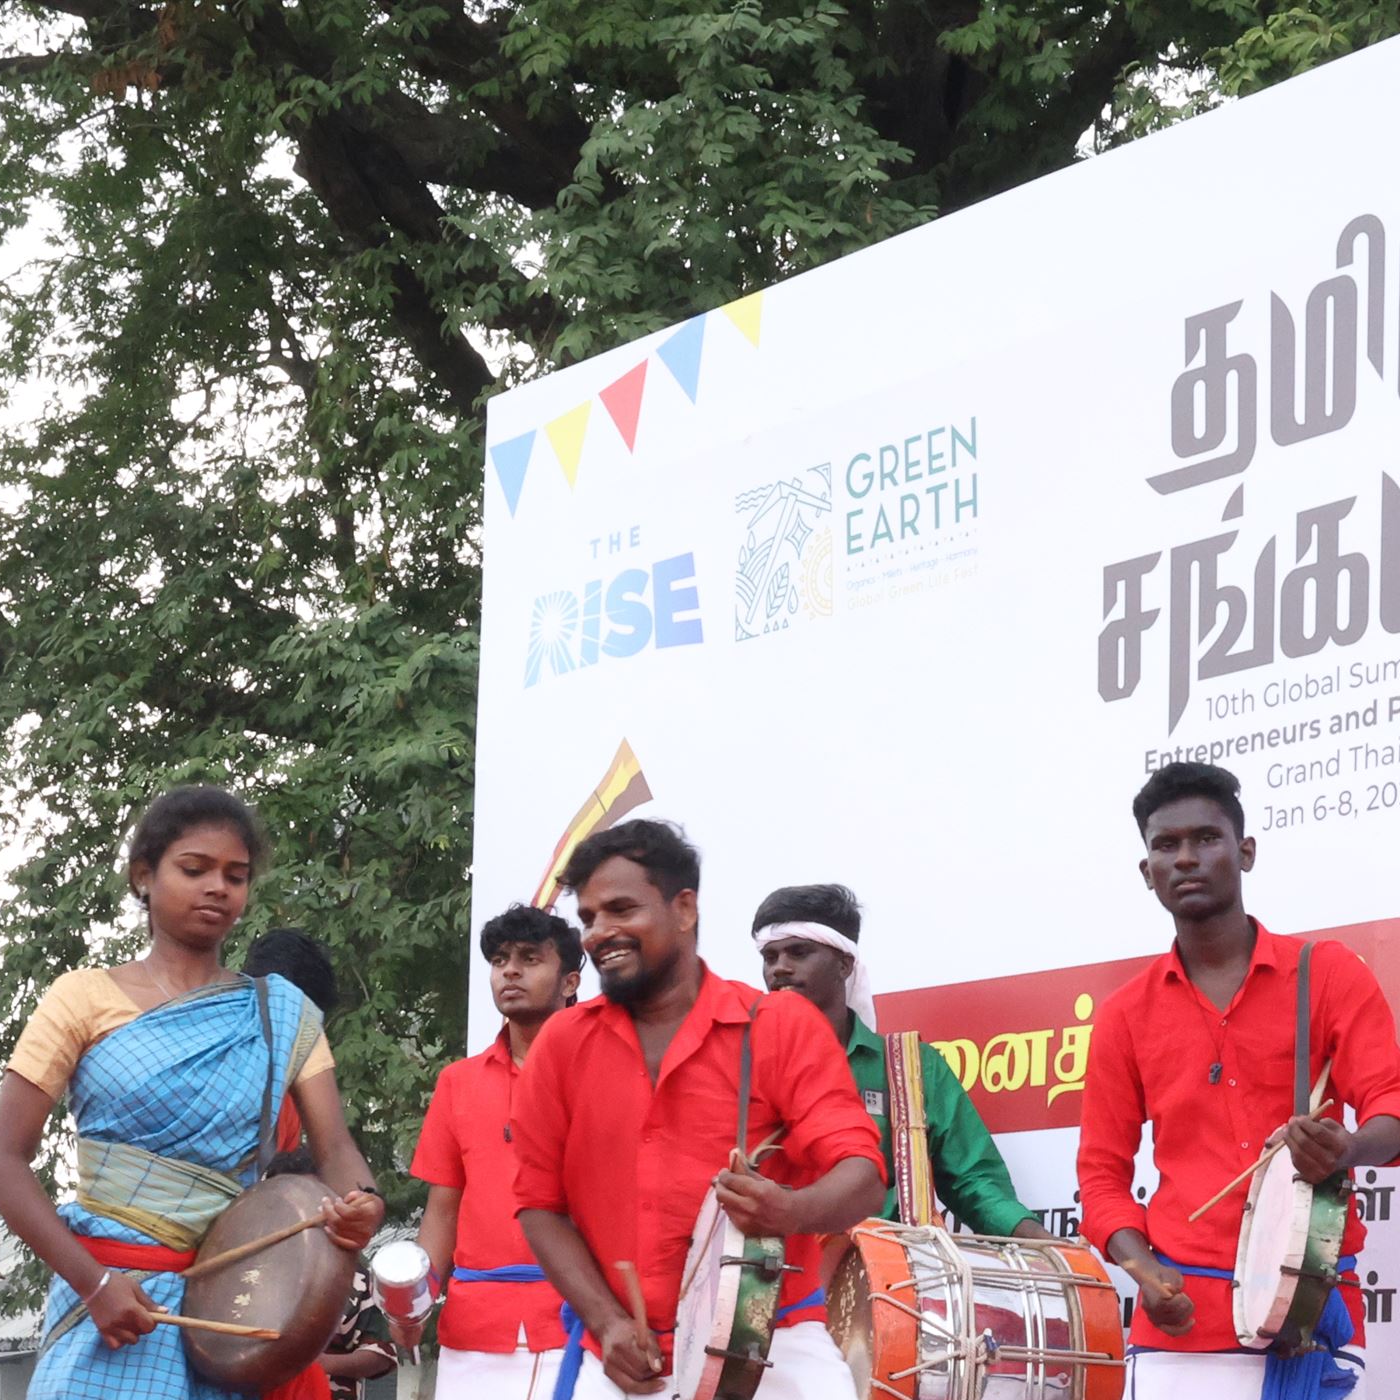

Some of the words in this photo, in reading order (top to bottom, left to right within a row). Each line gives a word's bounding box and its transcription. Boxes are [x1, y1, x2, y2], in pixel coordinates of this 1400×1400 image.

[845, 416, 978, 500] GREEN
[589, 525, 642, 560] THE
[845, 473, 979, 556] EARTH
[523, 551, 704, 690] RISE
[1204, 687, 1255, 722] 10th
[1263, 665, 1342, 708] Global
[1144, 718, 1322, 776] Entrepreneurs
[1329, 699, 1378, 736] and
[1266, 750, 1341, 790] Grand
[1262, 803, 1305, 832] Jan
[1312, 788, 1360, 820] 6-8,
